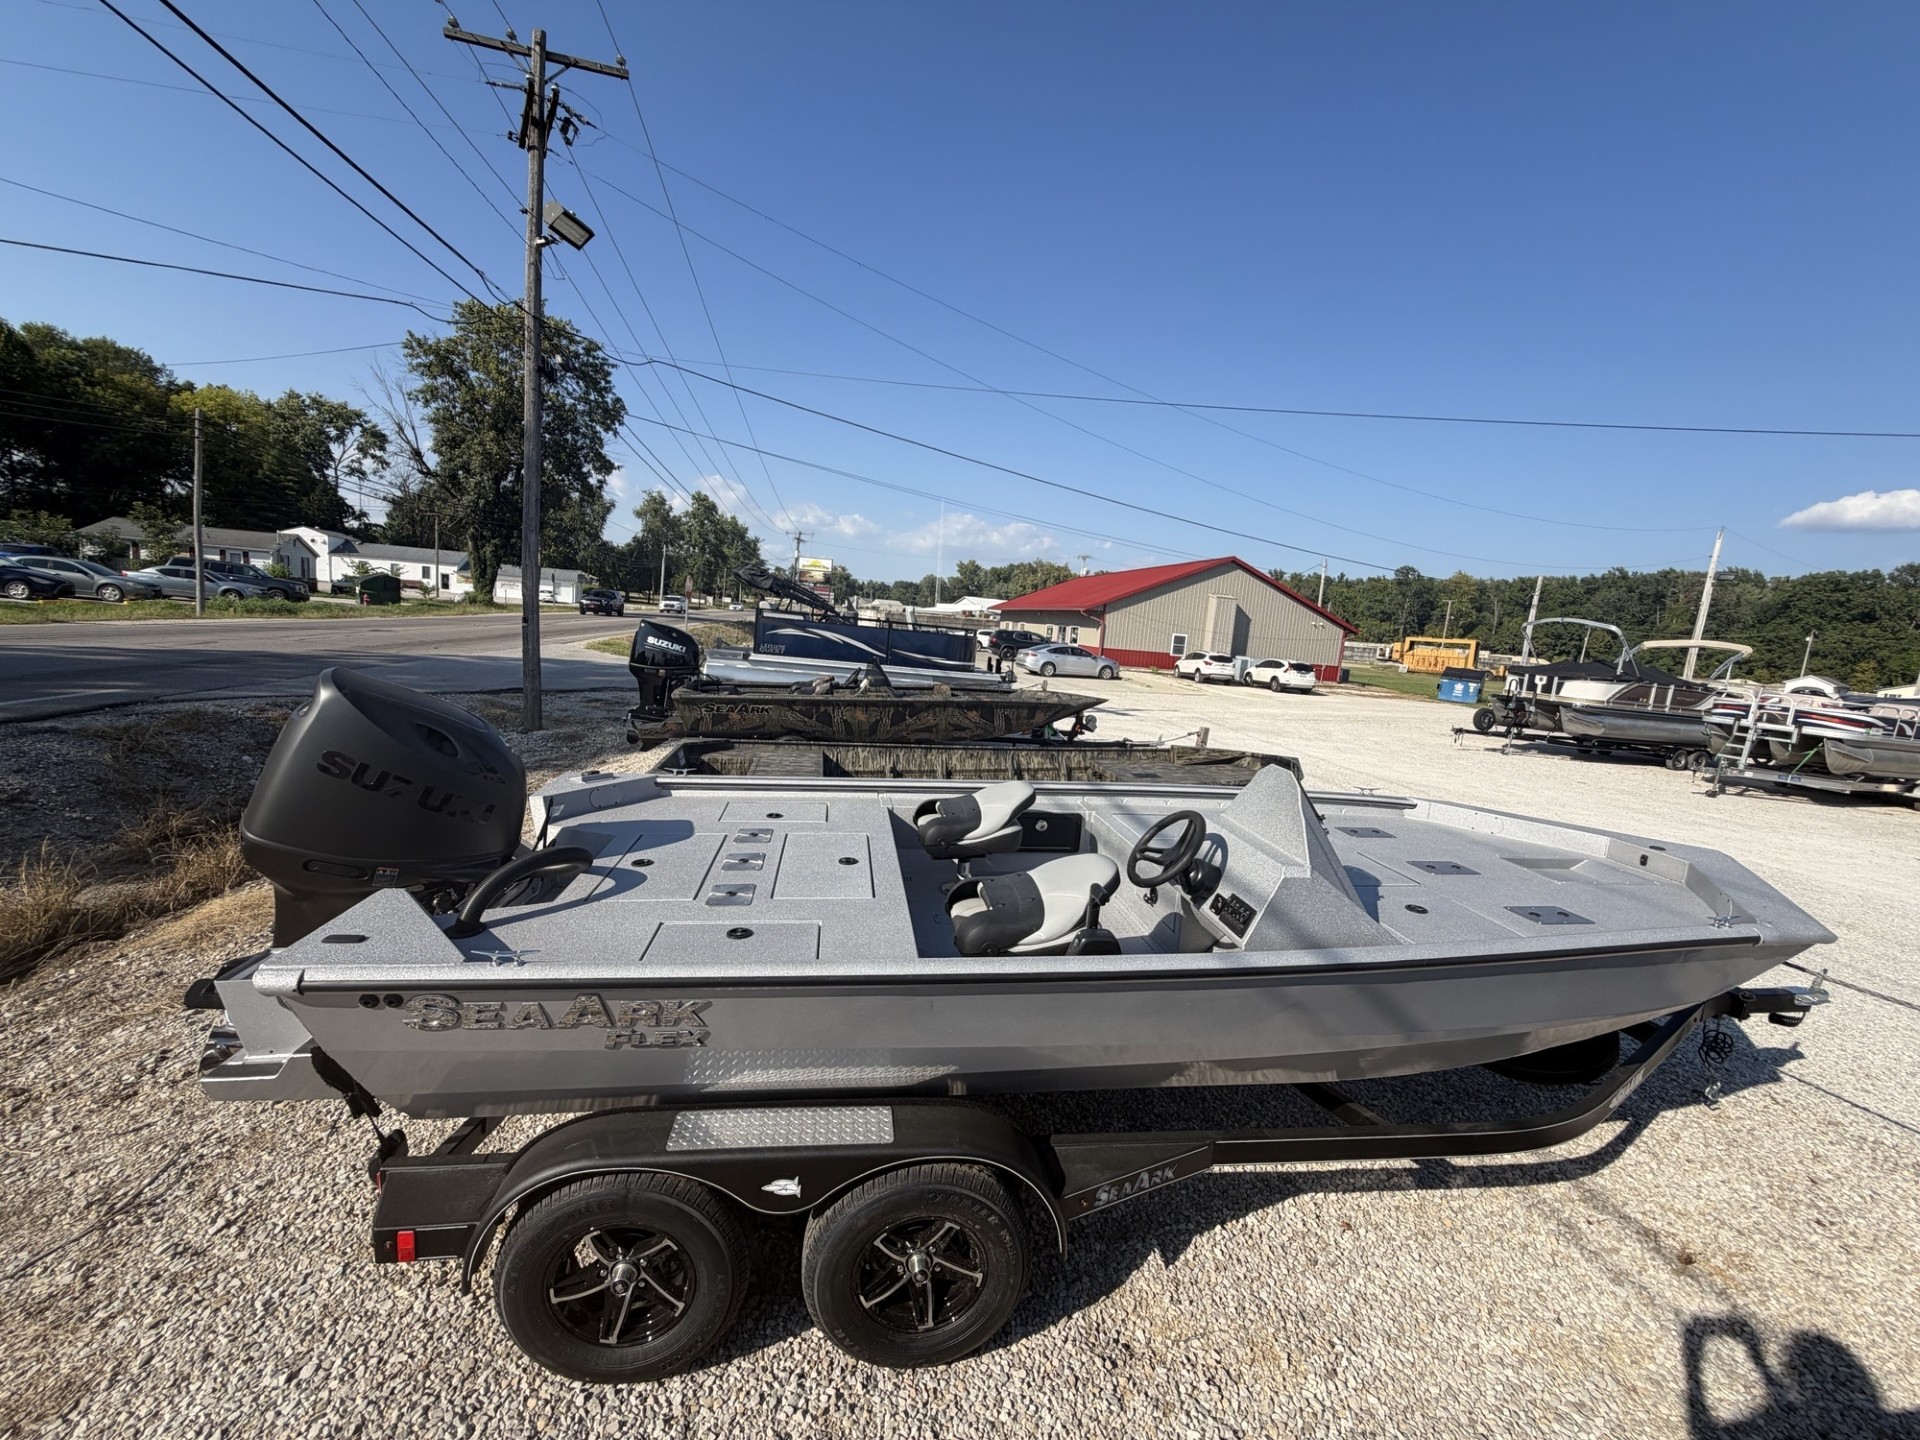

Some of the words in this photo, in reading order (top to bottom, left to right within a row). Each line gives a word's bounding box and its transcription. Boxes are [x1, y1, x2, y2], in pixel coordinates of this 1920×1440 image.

[646, 636, 686, 653] SUZUKI
[316, 750, 497, 825] SUZUKI
[604, 1029, 712, 1050] FLEX
